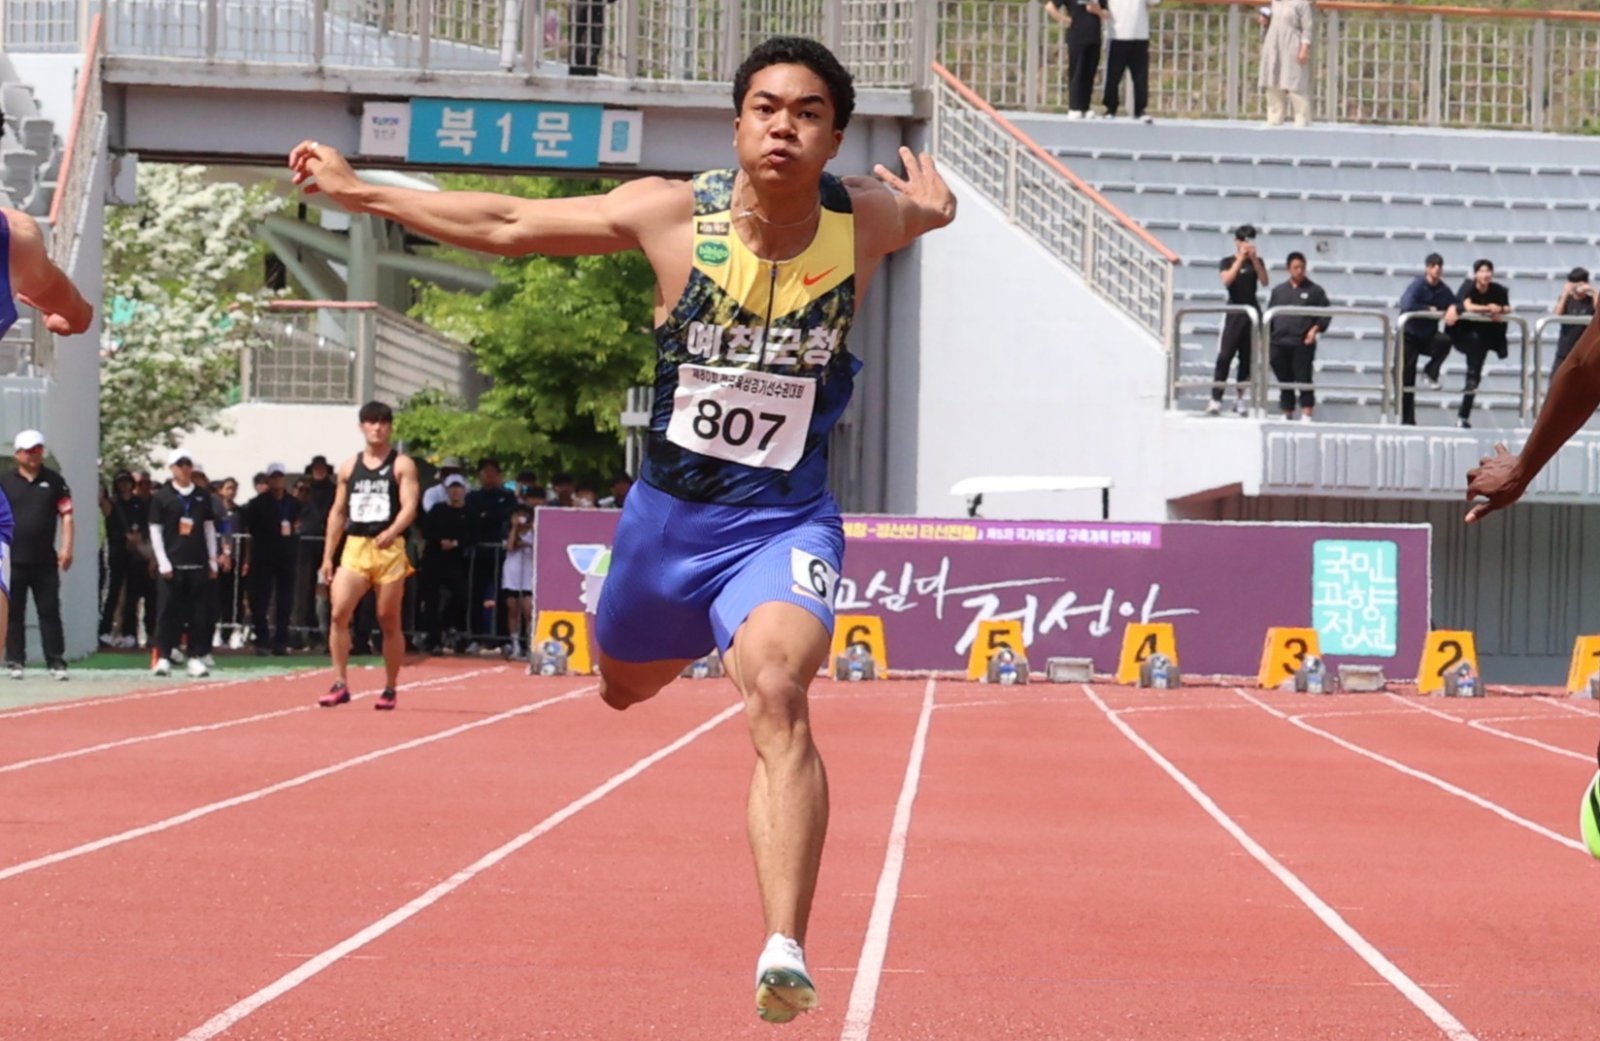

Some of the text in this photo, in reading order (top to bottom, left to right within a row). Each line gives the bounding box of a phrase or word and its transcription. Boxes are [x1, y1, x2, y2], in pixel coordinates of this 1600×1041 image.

[687, 321, 838, 367] 예천군청
[693, 399, 786, 452] 807
[808, 558, 828, 598] 6
[1320, 545, 1396, 585] 국민
[1313, 580, 1397, 622] 고향
[549, 619, 575, 657] 8
[1135, 632, 1160, 663] 4
[1320, 608, 1396, 650] 정선
[1282, 637, 1308, 674] 3
[1437, 639, 1463, 677] 2
